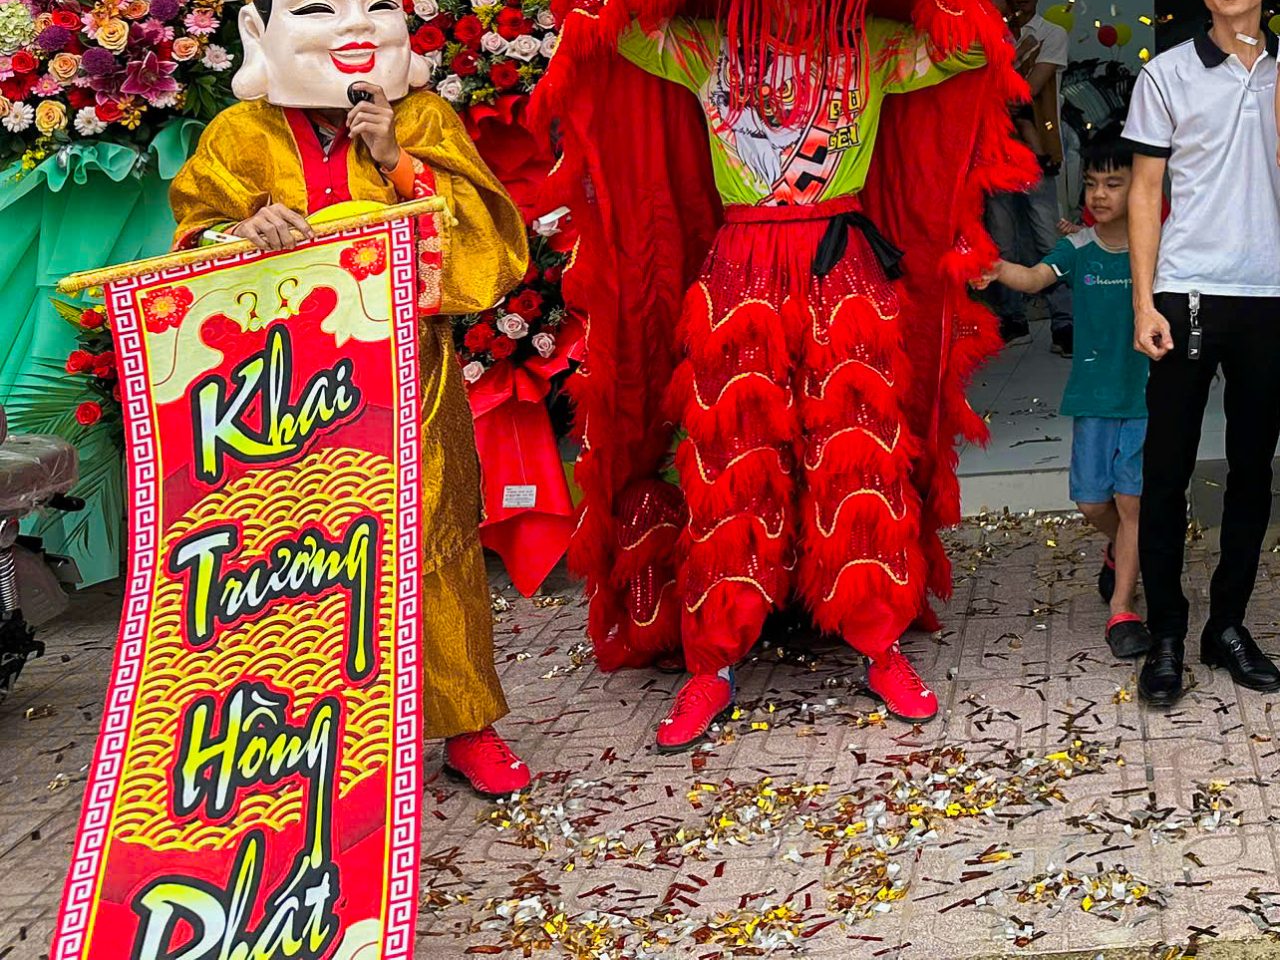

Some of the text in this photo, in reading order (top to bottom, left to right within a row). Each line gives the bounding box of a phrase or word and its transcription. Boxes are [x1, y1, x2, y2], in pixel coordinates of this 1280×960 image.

[195, 327, 357, 480] Khai
[174, 521, 373, 675] Trương
[180, 686, 334, 870] Hồng
[137, 836, 333, 960] Phát
